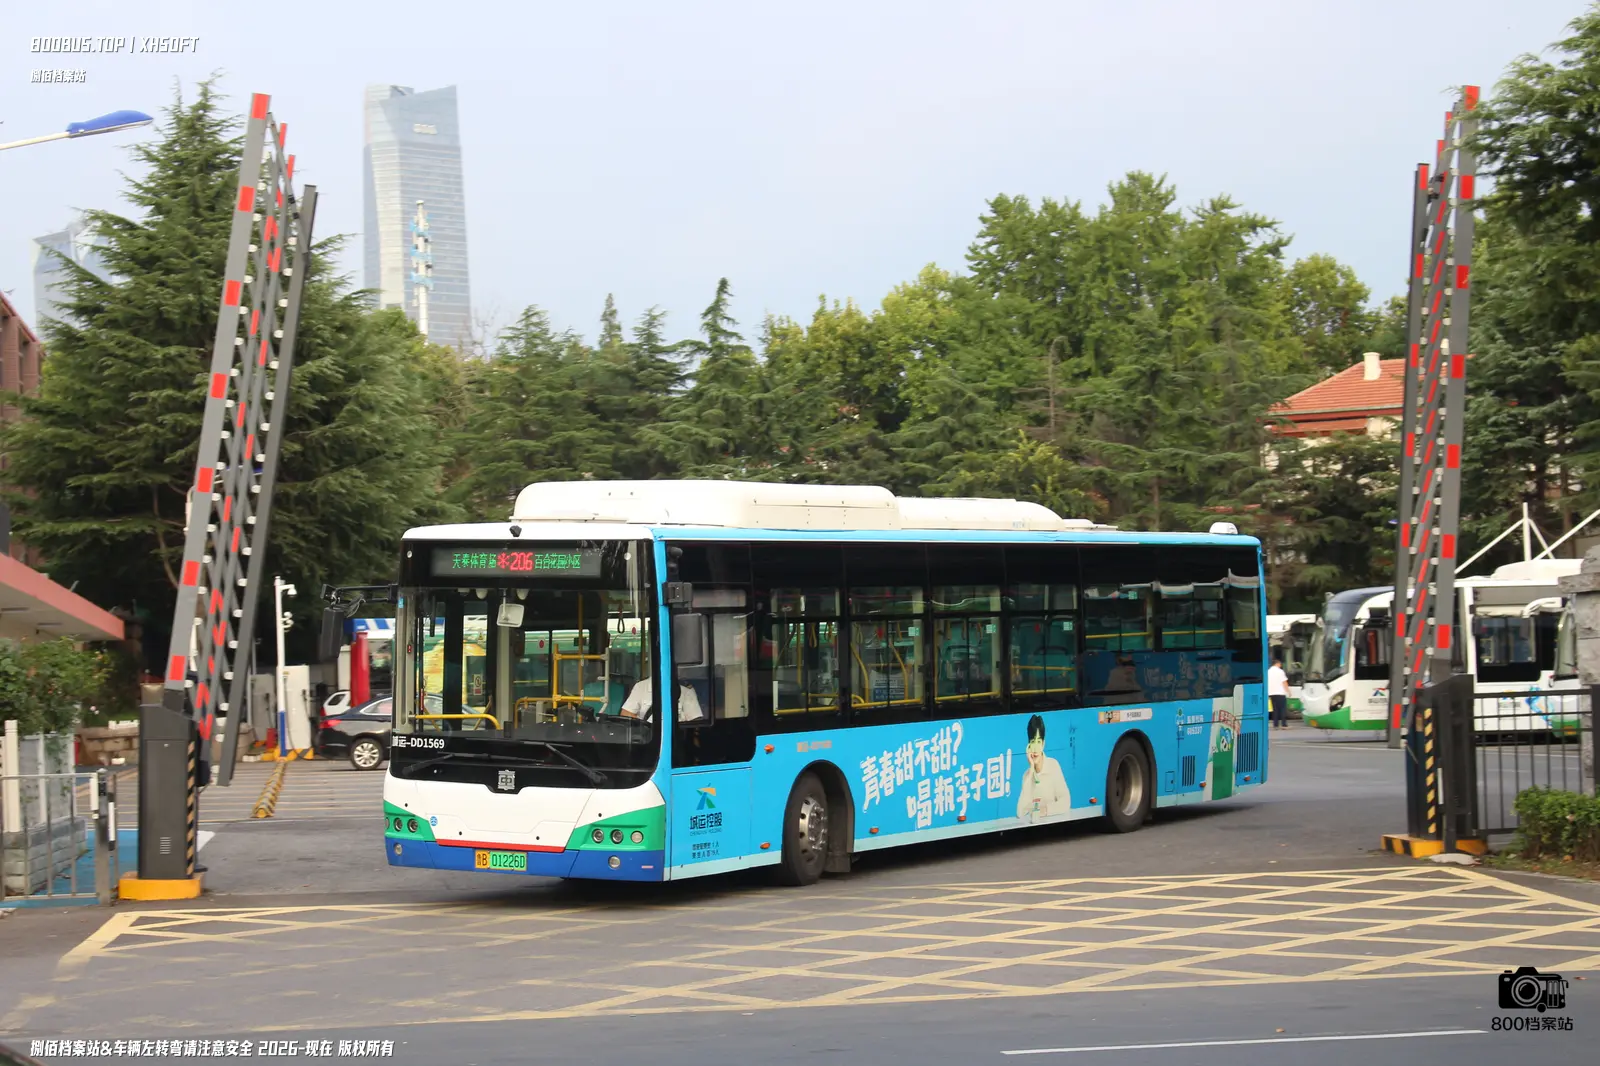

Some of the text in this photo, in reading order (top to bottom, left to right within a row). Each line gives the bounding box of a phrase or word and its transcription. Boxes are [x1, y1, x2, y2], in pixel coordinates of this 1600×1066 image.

[452, 551, 581, 571] 天泰体育场 206 百合花园小区
[689, 811, 723, 830] 城运控股
